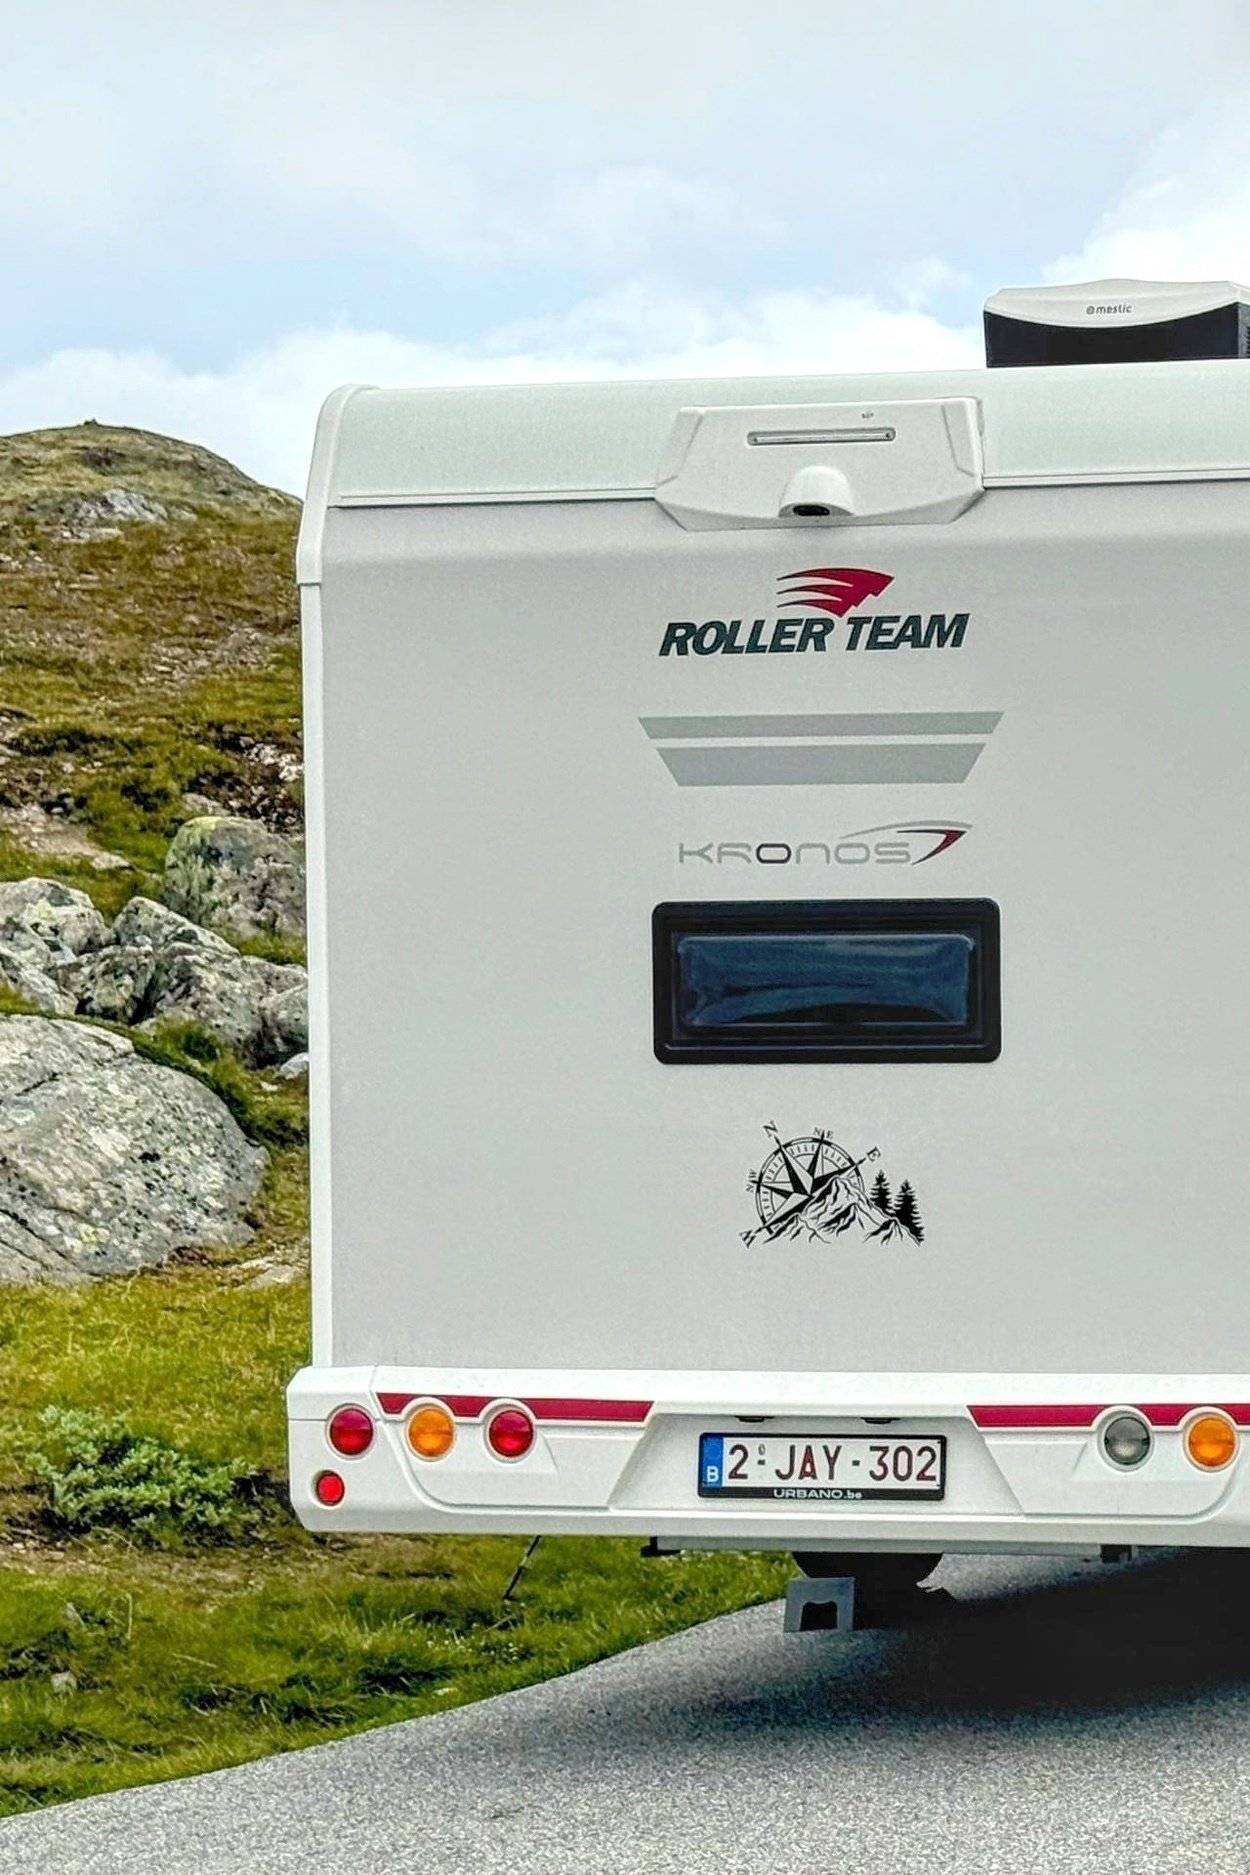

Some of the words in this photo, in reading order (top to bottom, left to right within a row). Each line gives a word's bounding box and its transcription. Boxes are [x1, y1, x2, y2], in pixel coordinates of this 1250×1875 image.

[658, 617, 835, 656] ROLLER
[846, 613, 970, 651] TEAM
[679, 842, 911, 865] KRONOS
[707, 1465, 719, 1482] B
[773, 1488, 863, 1500] URBANO.be
